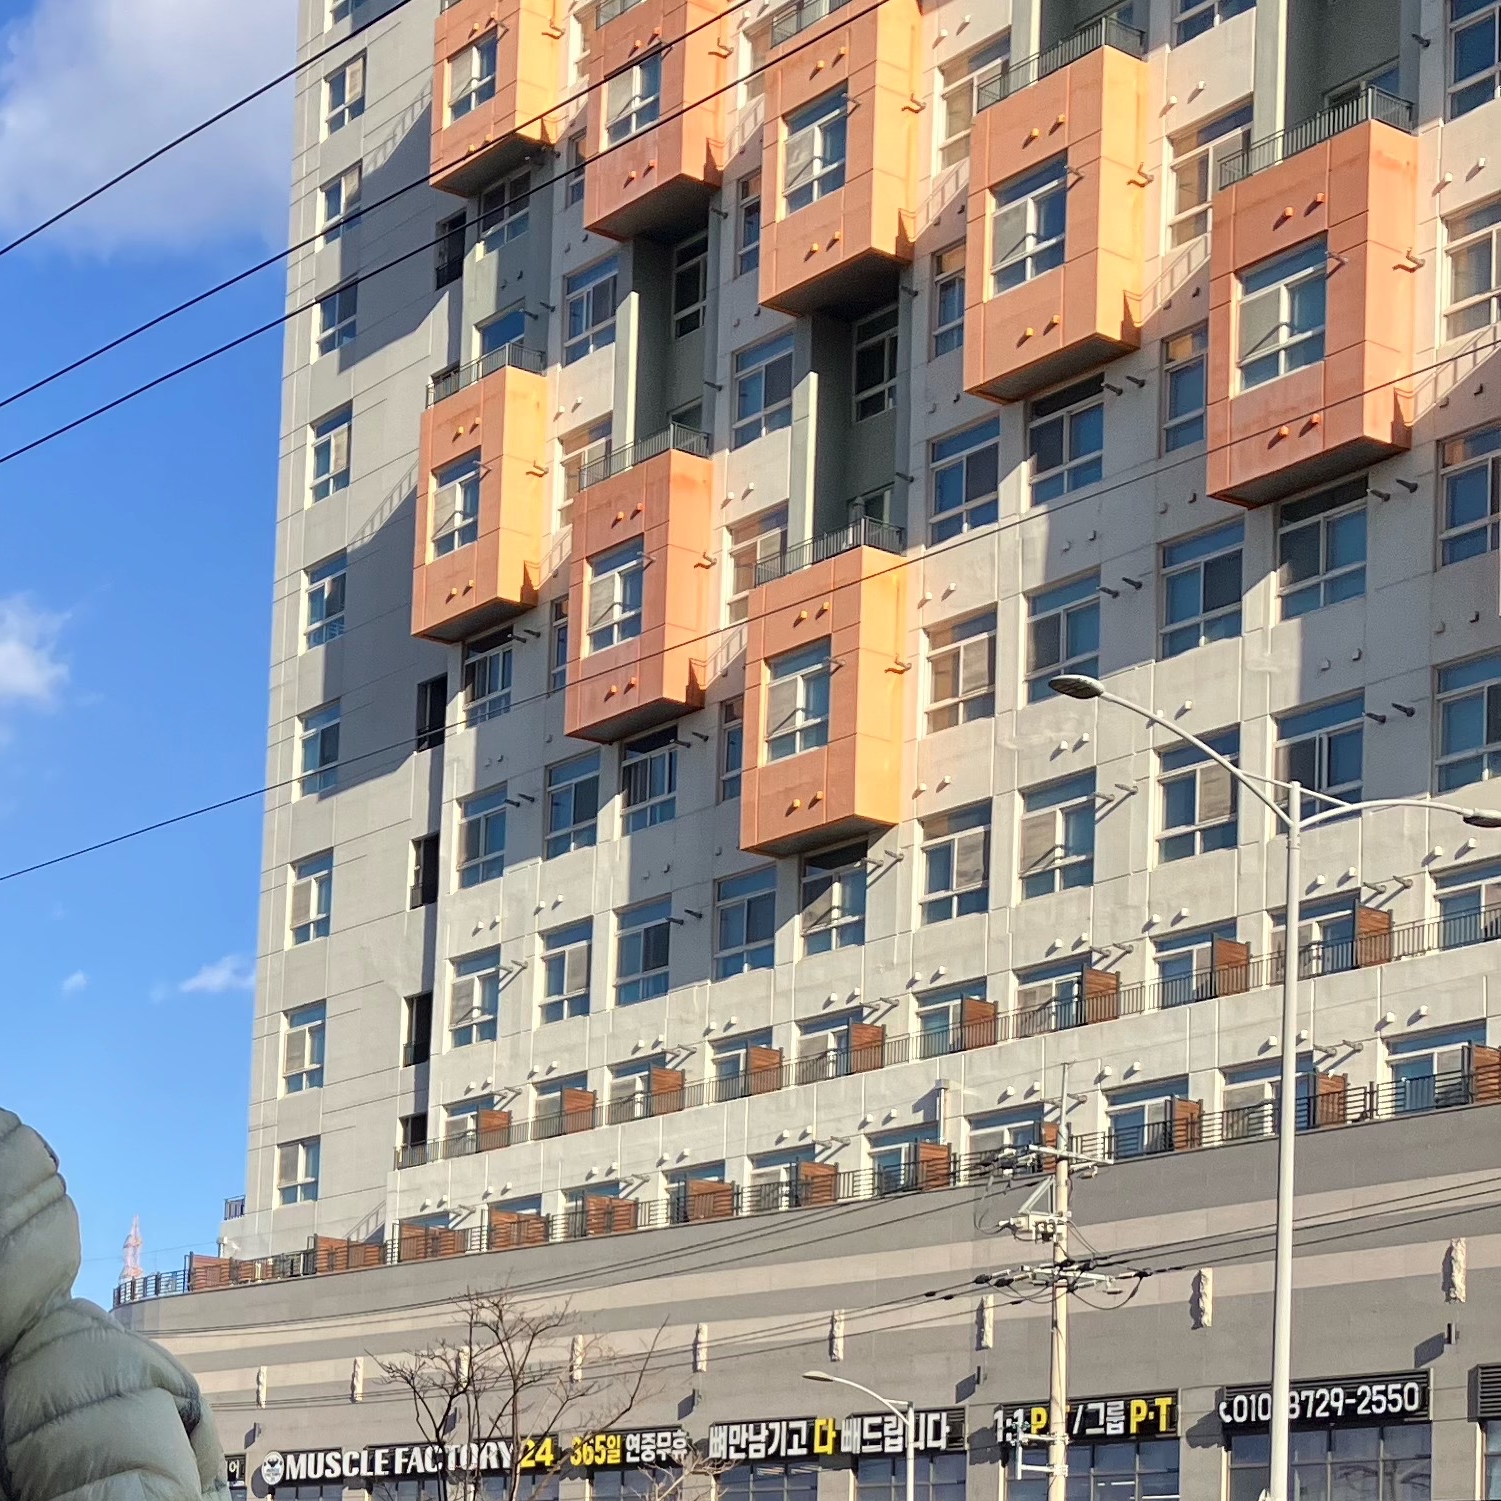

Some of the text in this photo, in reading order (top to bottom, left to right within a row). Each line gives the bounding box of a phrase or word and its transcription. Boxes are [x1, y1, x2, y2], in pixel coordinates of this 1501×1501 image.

[570, 1429, 688, 1466] 365일 연중무휴
[813, 1417, 837, 1455] 다
[841, 1411, 950, 1455] 빼드립니다
[285, 1449, 389, 1480] MUSCLE
[394, 1441, 512, 1475] FACTORY
[520, 1437, 555, 1468] 24
